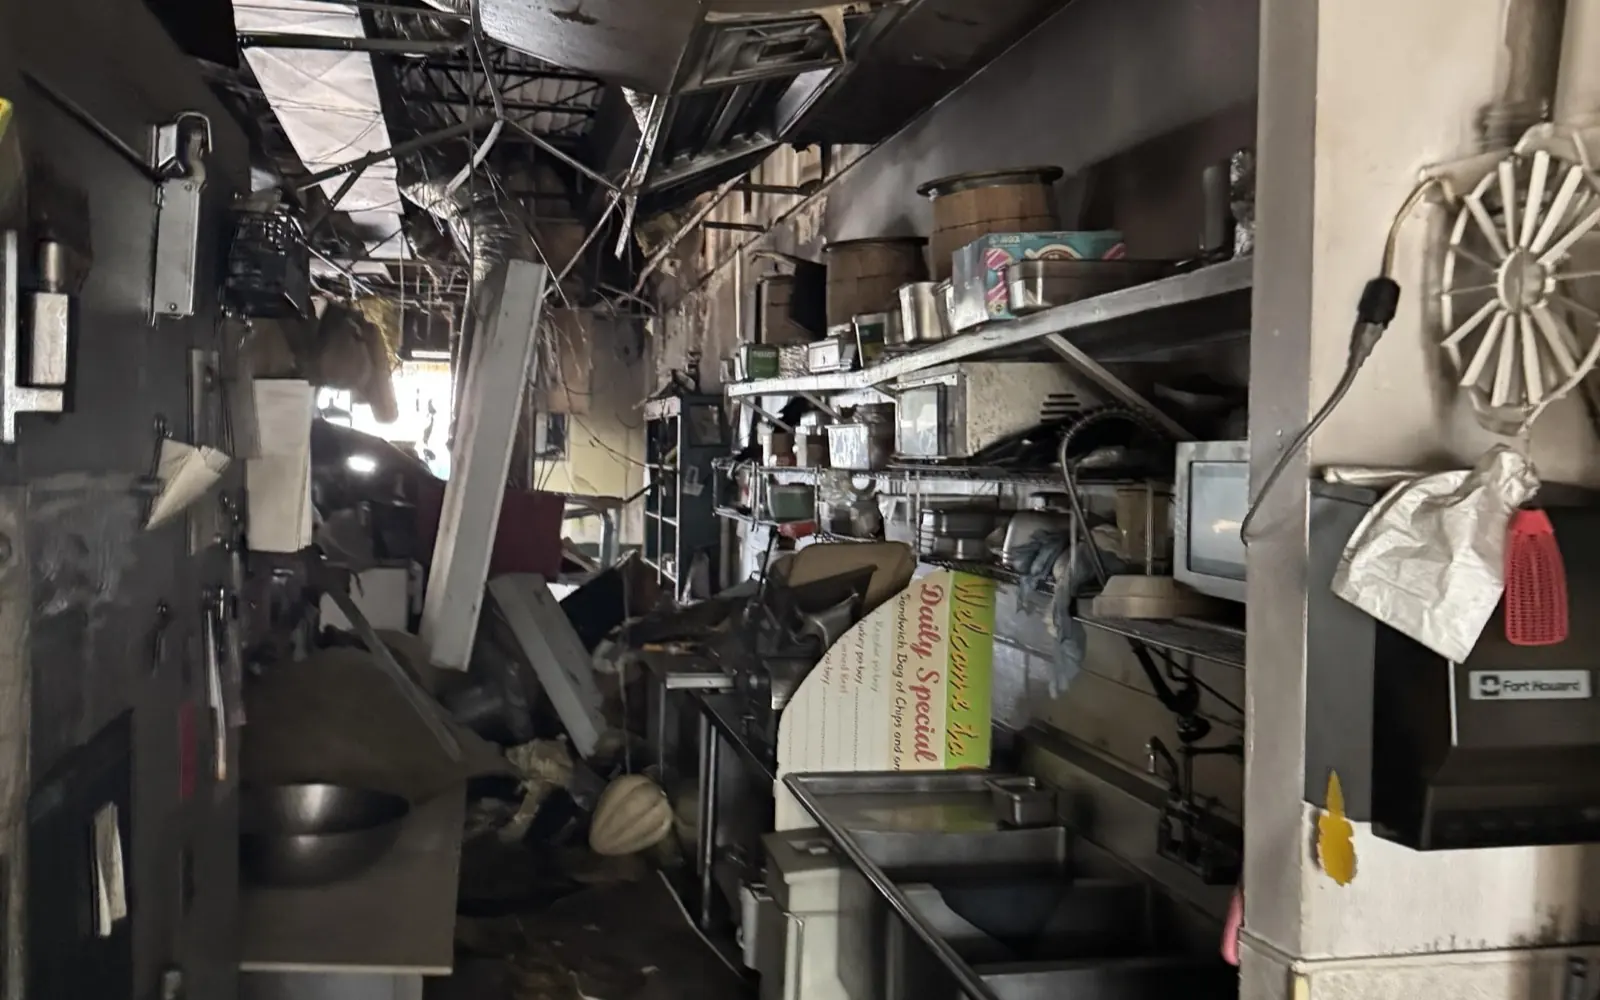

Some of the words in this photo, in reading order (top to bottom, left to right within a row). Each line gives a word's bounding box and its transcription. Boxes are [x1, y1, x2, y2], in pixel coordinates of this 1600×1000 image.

[910, 583, 944, 660] Daily
[949, 578, 991, 712] Welcome
[891, 652, 908, 678] Bag
[895, 680, 907, 693] of
[1503, 680, 1529, 692] Fort
[1532, 680, 1580, 692] Howard
[890, 696, 908, 727] Chips
[908, 666, 941, 763] Special
[893, 731, 904, 754] and
[946, 721, 980, 758] to
